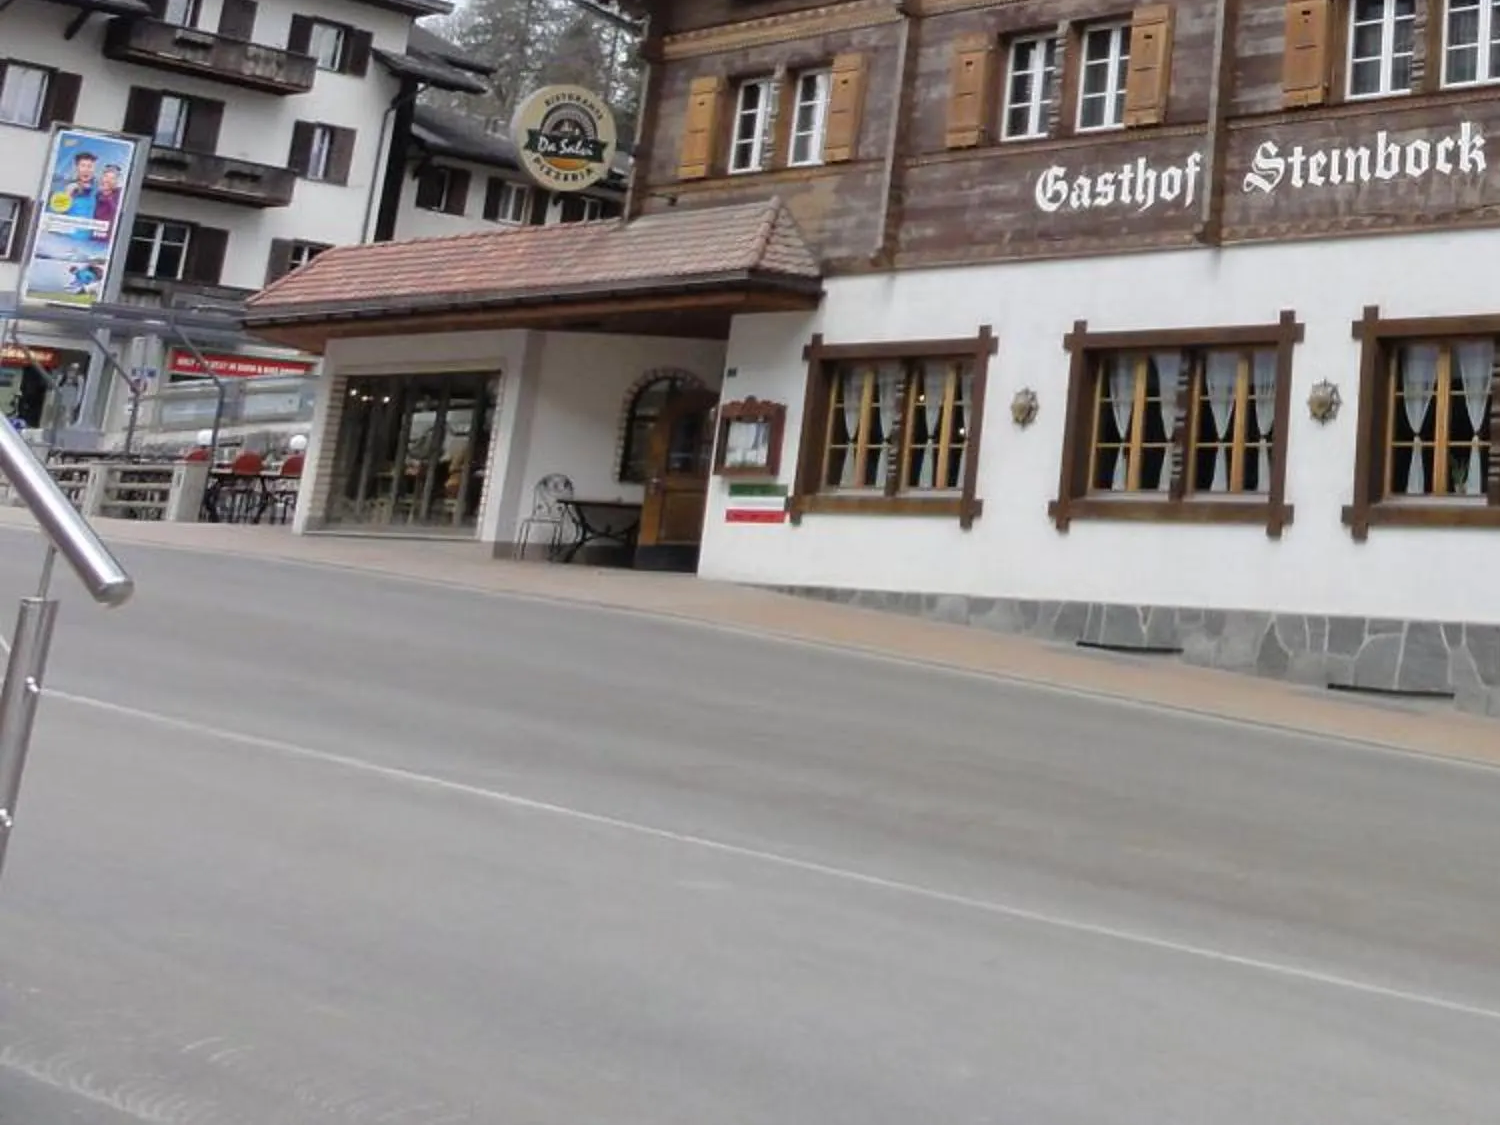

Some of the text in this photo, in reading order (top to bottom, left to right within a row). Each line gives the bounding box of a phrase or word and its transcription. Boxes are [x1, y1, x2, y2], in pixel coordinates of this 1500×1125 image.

[537, 135, 557, 153] Da
[1035, 121, 1487, 212] Gasthof Steinbock
